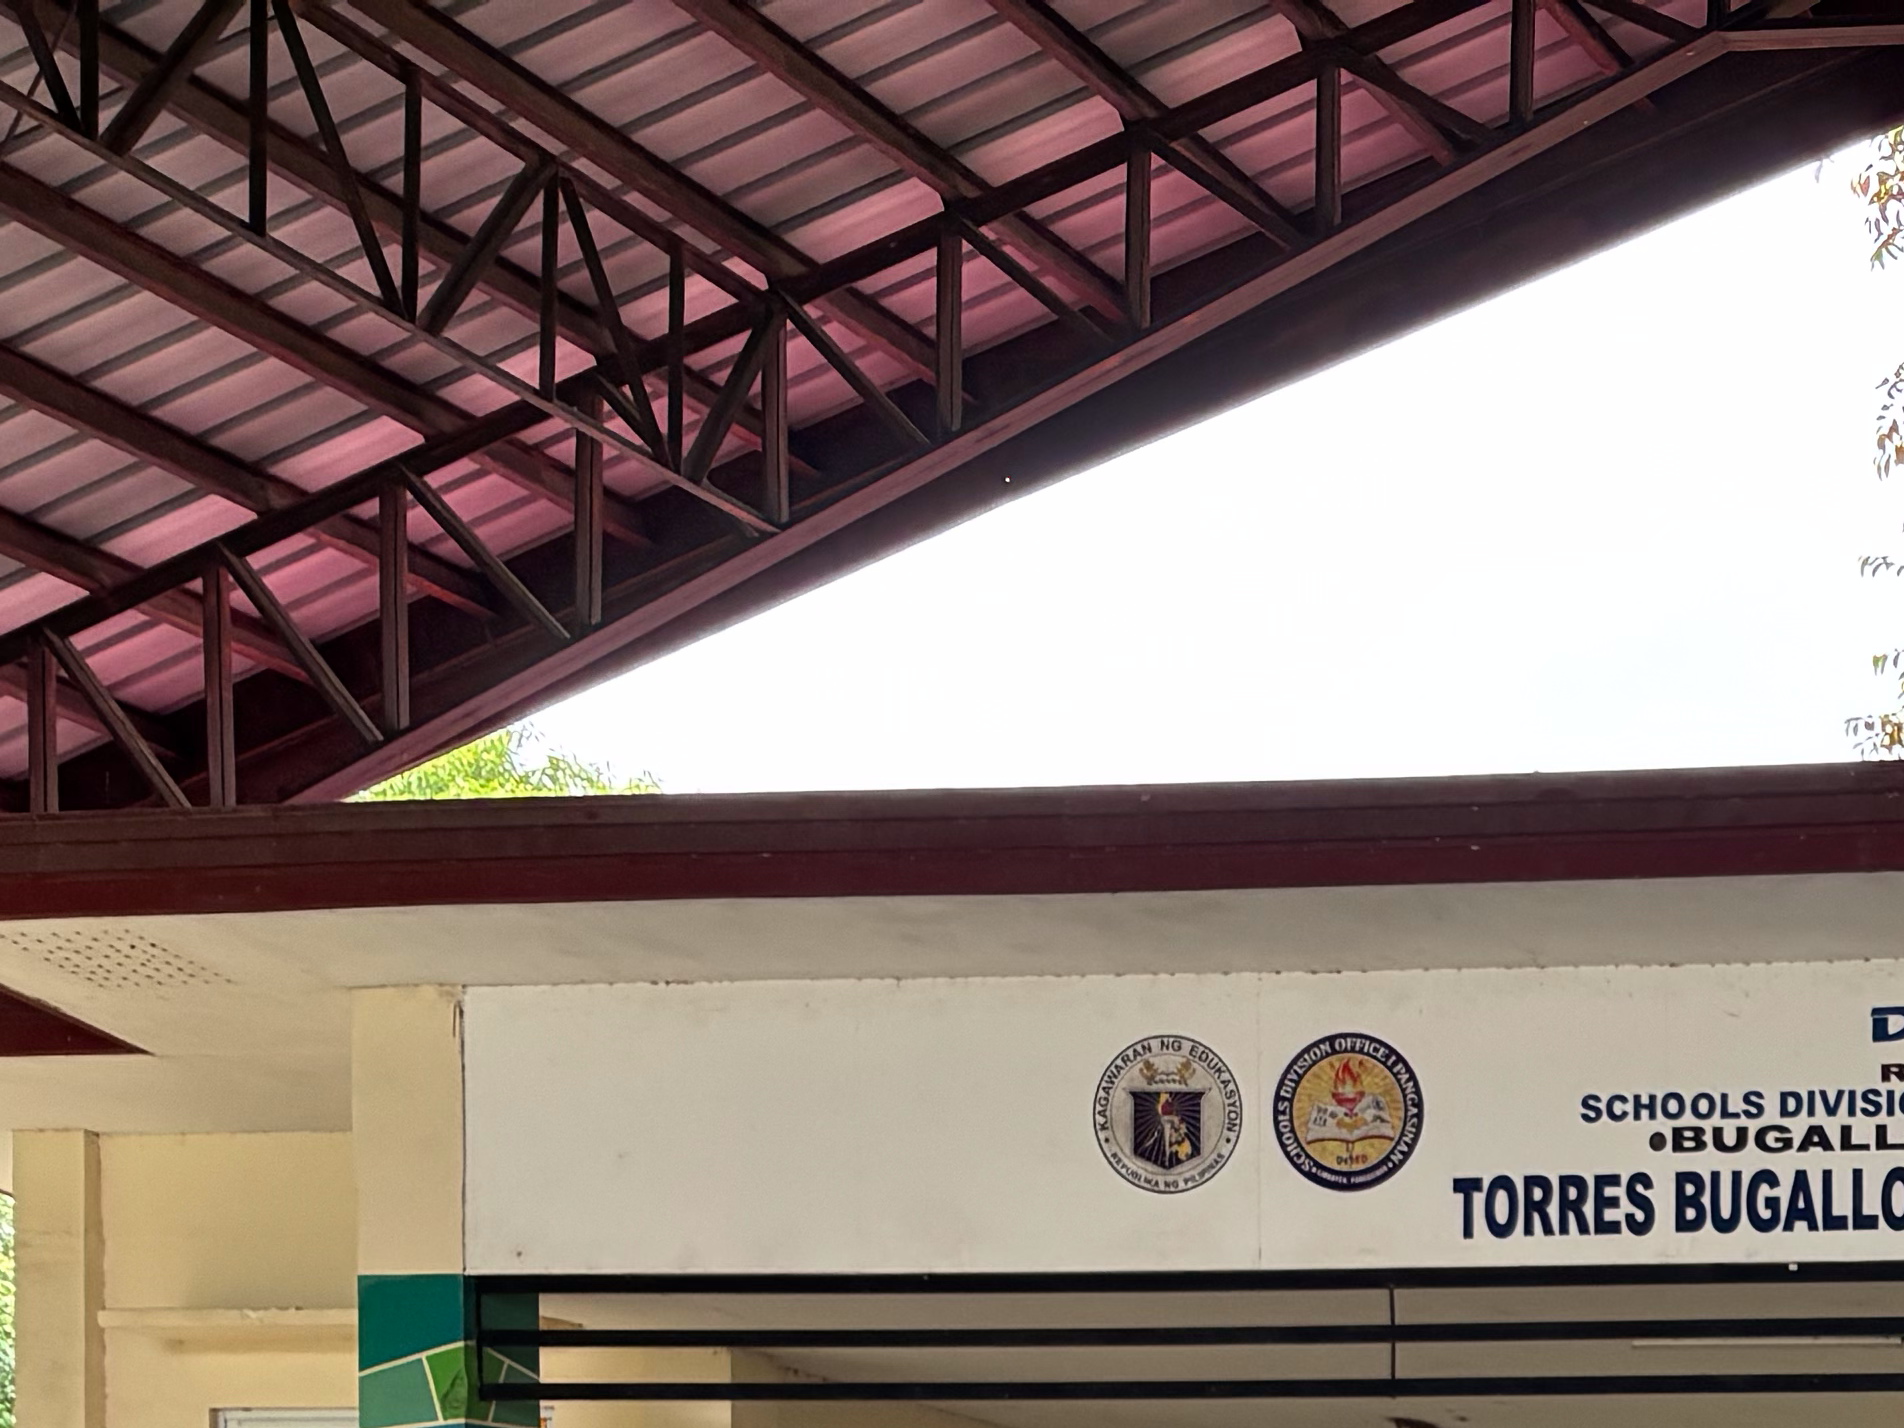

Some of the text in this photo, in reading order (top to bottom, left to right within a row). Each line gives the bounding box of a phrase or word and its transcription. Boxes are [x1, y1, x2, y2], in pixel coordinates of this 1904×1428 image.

[1280, 1041, 1332, 1099] DIVISION
[1334, 1037, 1389, 1061] OFFICE
[1097, 1039, 1240, 1133] KAGAWARAN NG EDUKASYON
[1393, 1063, 1418, 1166] PANGASINAN
[1580, 1090, 1765, 1123] SCHOOLS
[1278, 1101, 1314, 1172] SCHOOLS
[1164, 1180, 1179, 1189] NG
[1453, 1171, 1656, 1240] TORRES
